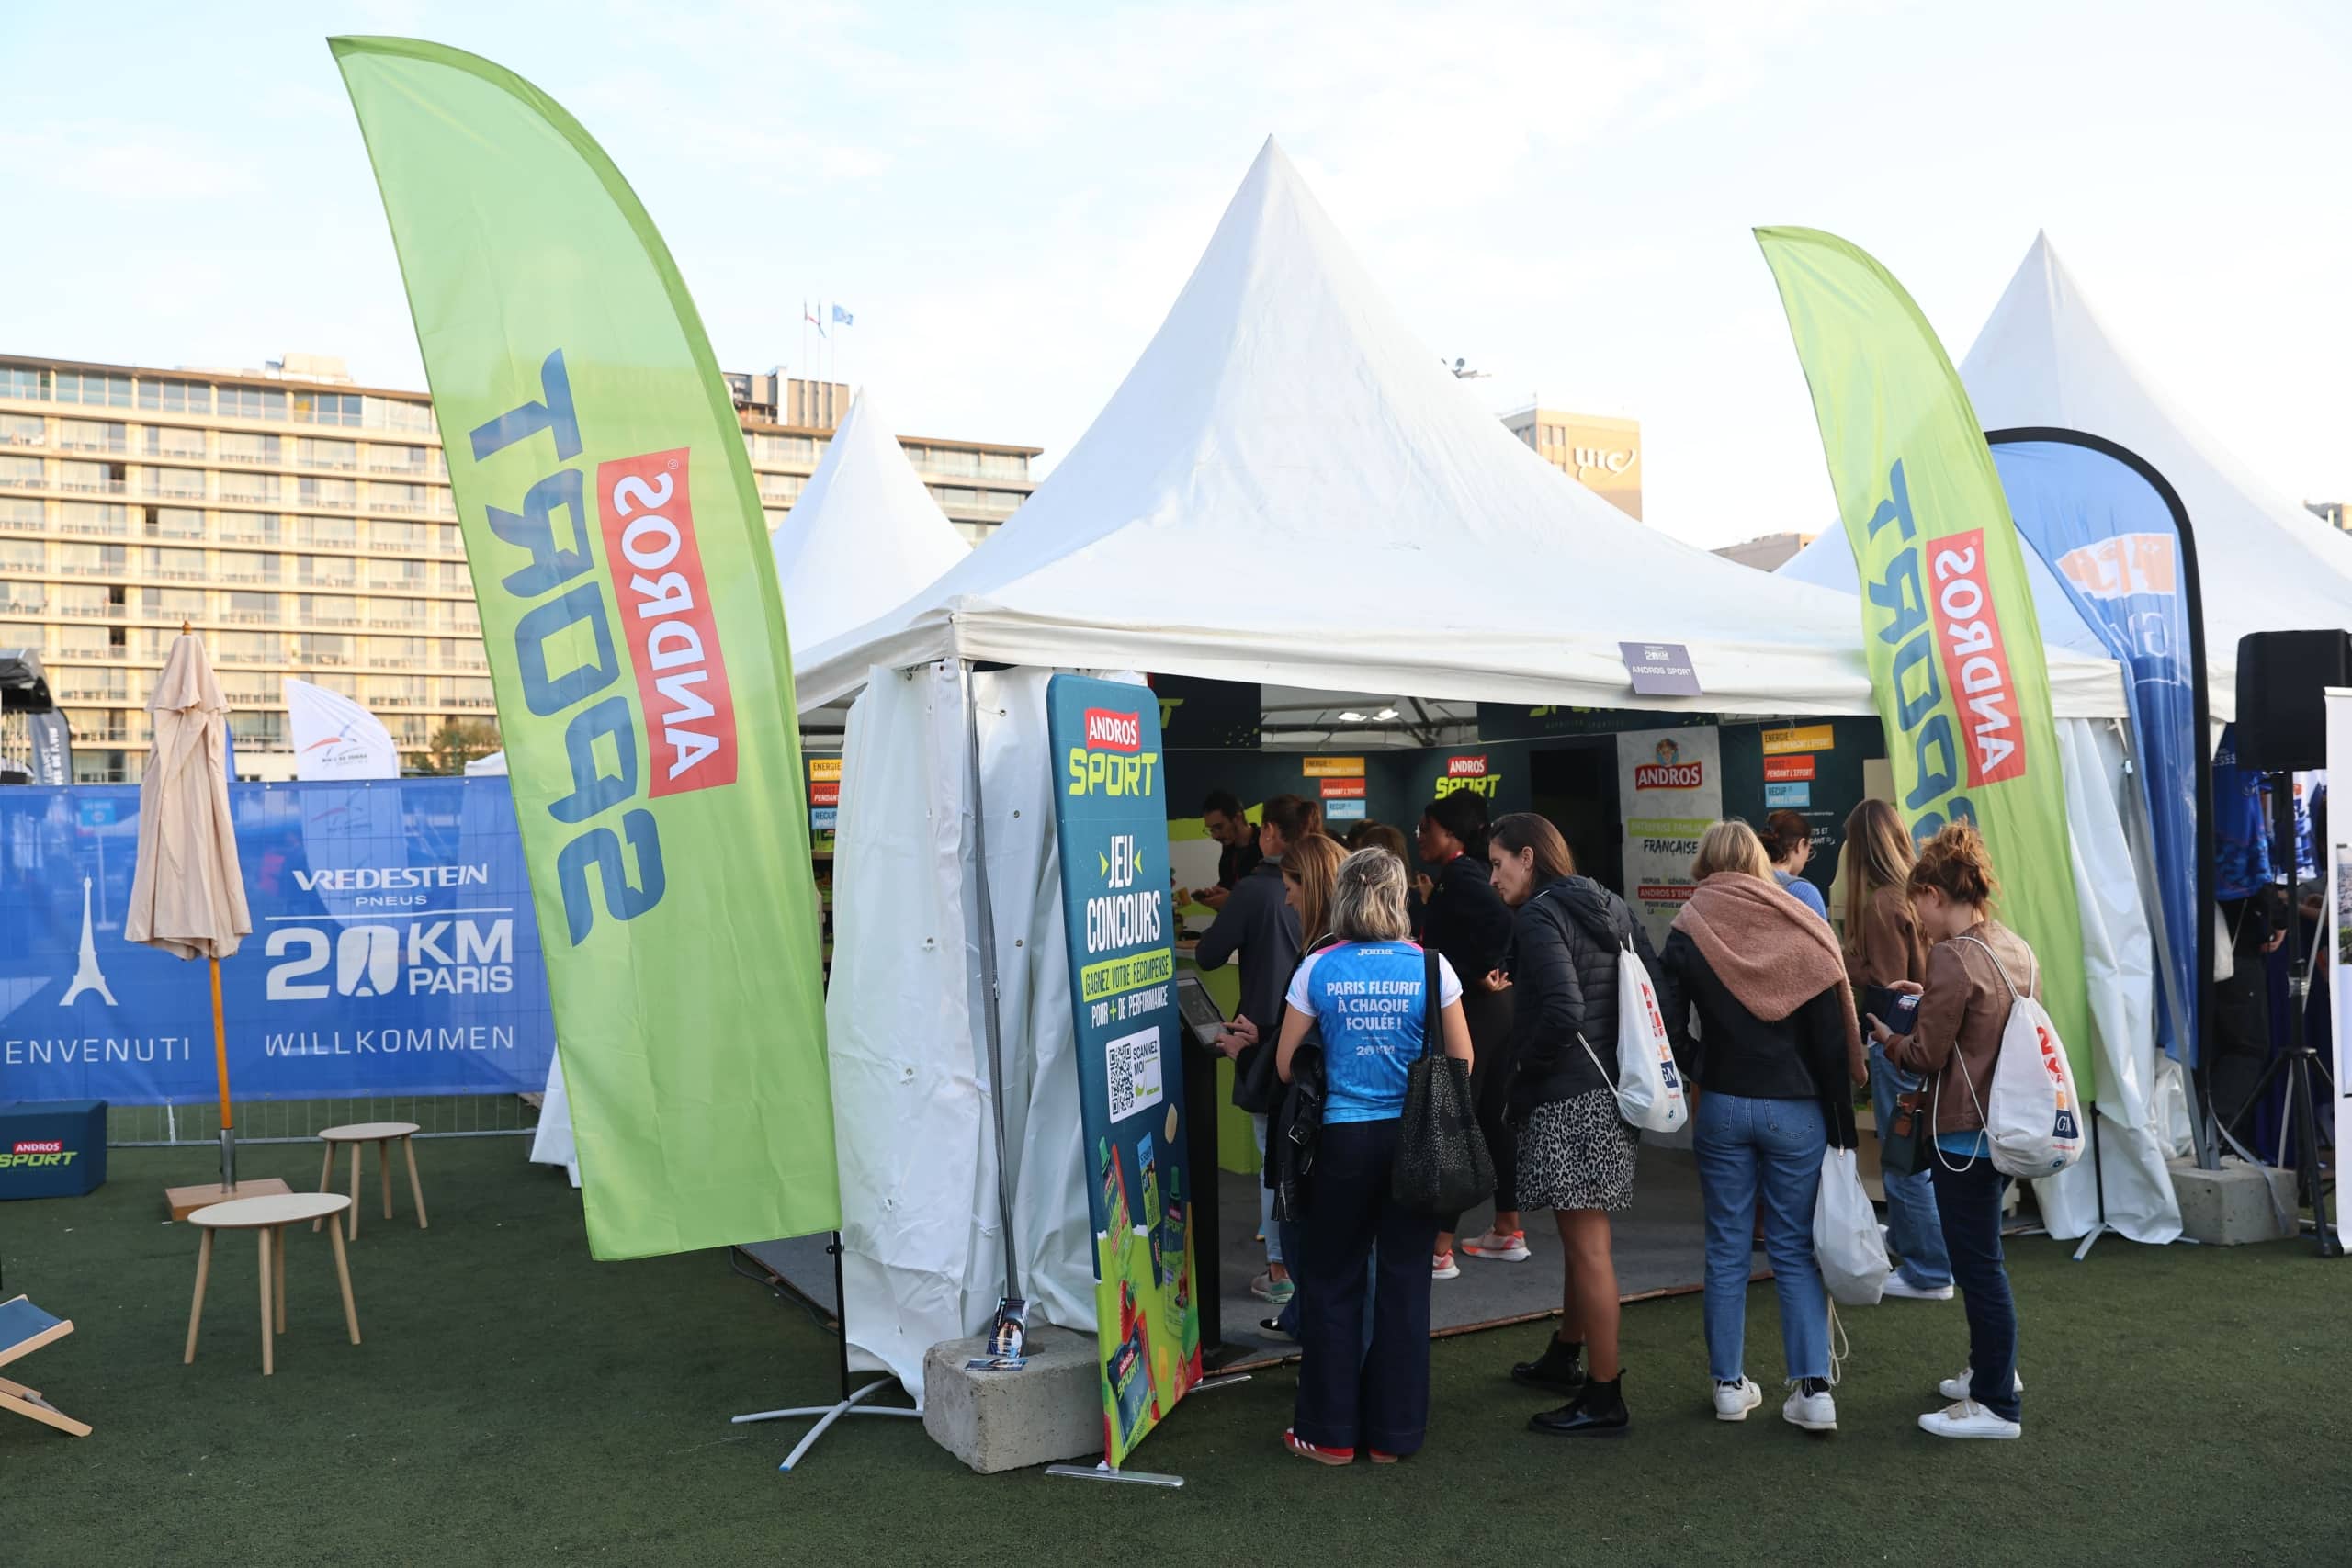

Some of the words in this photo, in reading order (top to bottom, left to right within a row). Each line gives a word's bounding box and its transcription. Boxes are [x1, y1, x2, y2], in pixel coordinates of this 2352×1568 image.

[1632, 665, 1666, 674] ANDROS
[1667, 667, 1691, 676] SPORT
[1089, 715, 1138, 746] ANDROS
[1069, 747, 1158, 796] SPORT
[1450, 759, 1485, 773] ANDROS
[1638, 765, 1700, 786] ANDROS
[1644, 839, 1699, 856] FRANÇAISE
[1108, 835, 1134, 889] JEU
[293, 863, 488, 891] VREDESTEIN
[356, 895, 427, 908] PNEUS
[1086, 890, 1161, 954] CONCOURS
[265, 925, 399, 1000] 20
[408, 919, 513, 965] KM
[409, 965, 513, 995] PARIS
[1086, 968, 1110, 996] GAGNEZ
[1112, 964, 1131, 989] VOTRE
[1133, 955, 1170, 985] RÉCOMPENSE
[1327, 982, 1365, 996] PARIS
[1368, 981, 1422, 995] FLEURIT
[1091, 1001, 1109, 1029] POUR
[1118, 997, 1126, 1021] DE
[1128, 985, 1169, 1017] PERFORMANCE
[1338, 997, 1347, 1013] À
[1350, 998, 1409, 1013] CHAQUE
[1346, 1013, 1395, 1030] FOULÉE
[1396, 1018, 1402, 1030] !
[6, 1037, 189, 1064] ENVENUTI
[266, 1026, 514, 1056] WILLKOMMEN
[1133, 1040, 1158, 1057] SCANNEZ
[1133, 1059, 1145, 1076] MOI
[16, 1142, 60, 1153] ANDROS
[0, 1151, 78, 1168] SPORT
